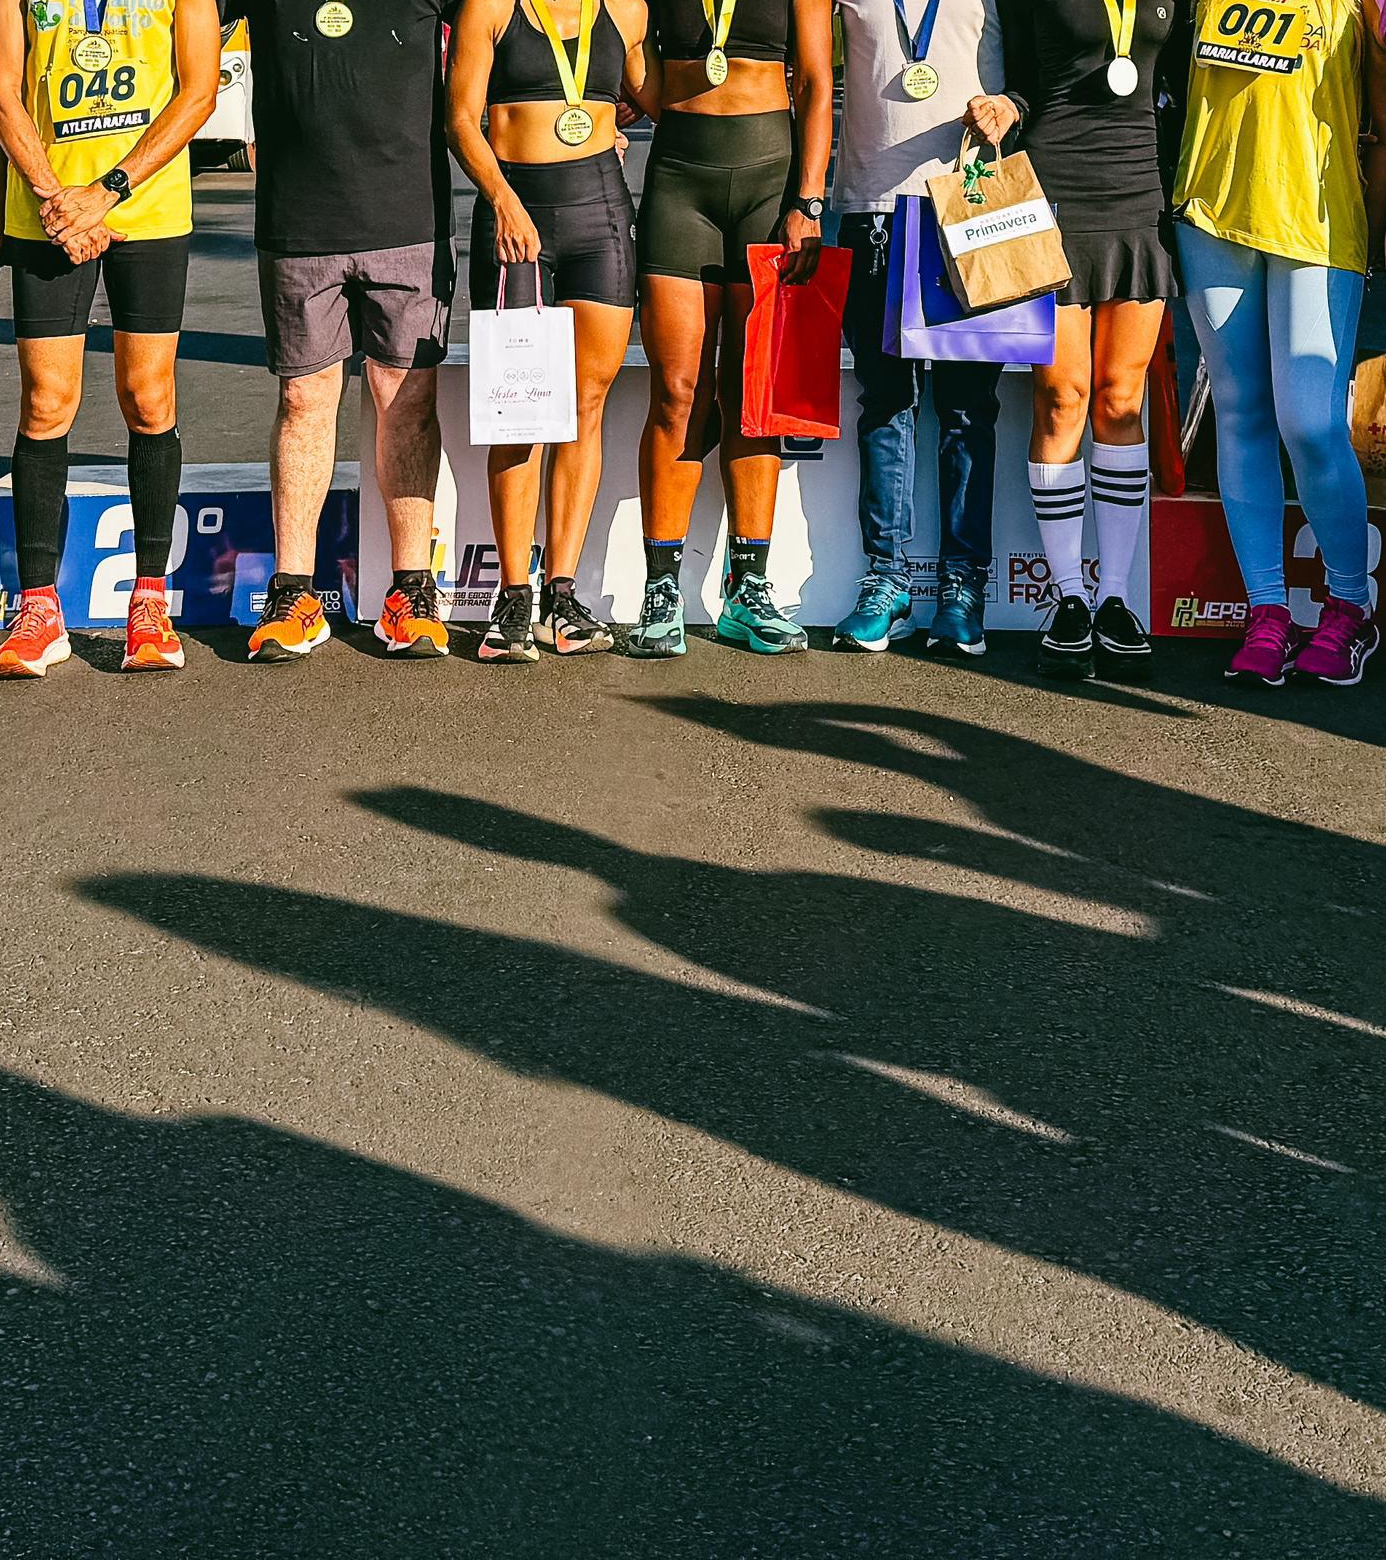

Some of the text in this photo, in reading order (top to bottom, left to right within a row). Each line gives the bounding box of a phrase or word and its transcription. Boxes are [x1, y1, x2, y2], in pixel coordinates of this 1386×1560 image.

[1217, 3, 1296, 45] 001
[1199, 44, 1237, 62] MARIA
[1237, 50, 1277, 68] CLARA
[59, 66, 136, 109] 048
[61, 112, 143, 136] ATLETA RAFAEL
[965, 212, 1037, 241] Primavera
[1195, 601, 1248, 620] JEPS
